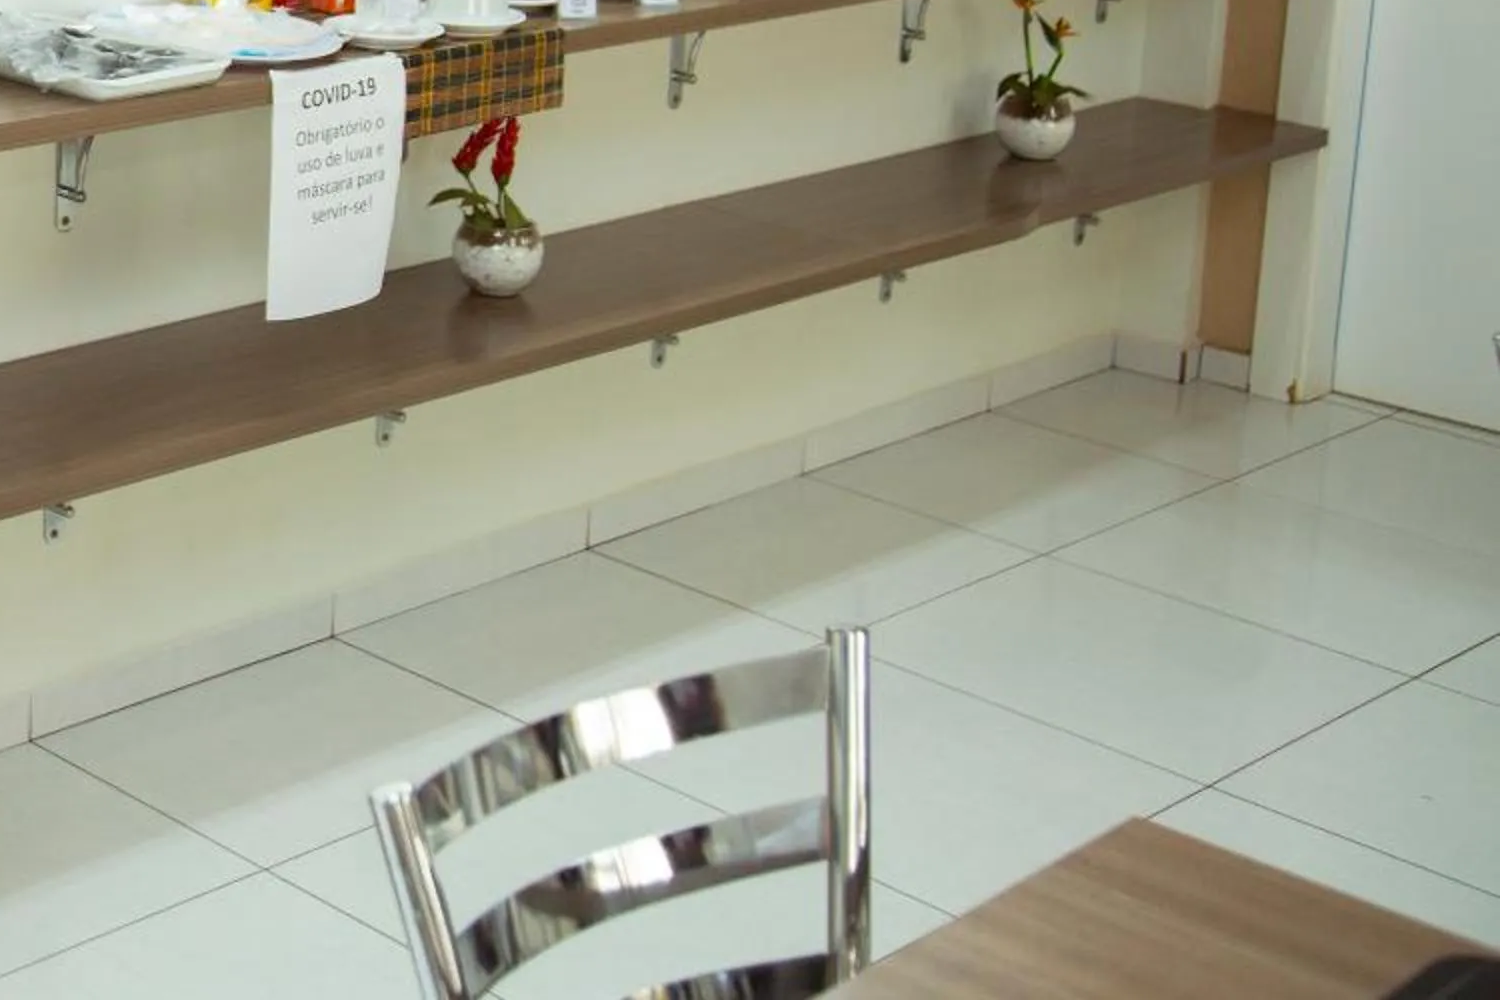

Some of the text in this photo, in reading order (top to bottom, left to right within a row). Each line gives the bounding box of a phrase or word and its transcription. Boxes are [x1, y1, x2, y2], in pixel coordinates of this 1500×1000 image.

[301, 76, 377, 109] COVID-19
[295, 116, 385, 147] Obrigatório o
[297, 143, 385, 174] uso de luva e
[296, 168, 385, 201] máscara para
[311, 192, 373, 225] servir-se!
